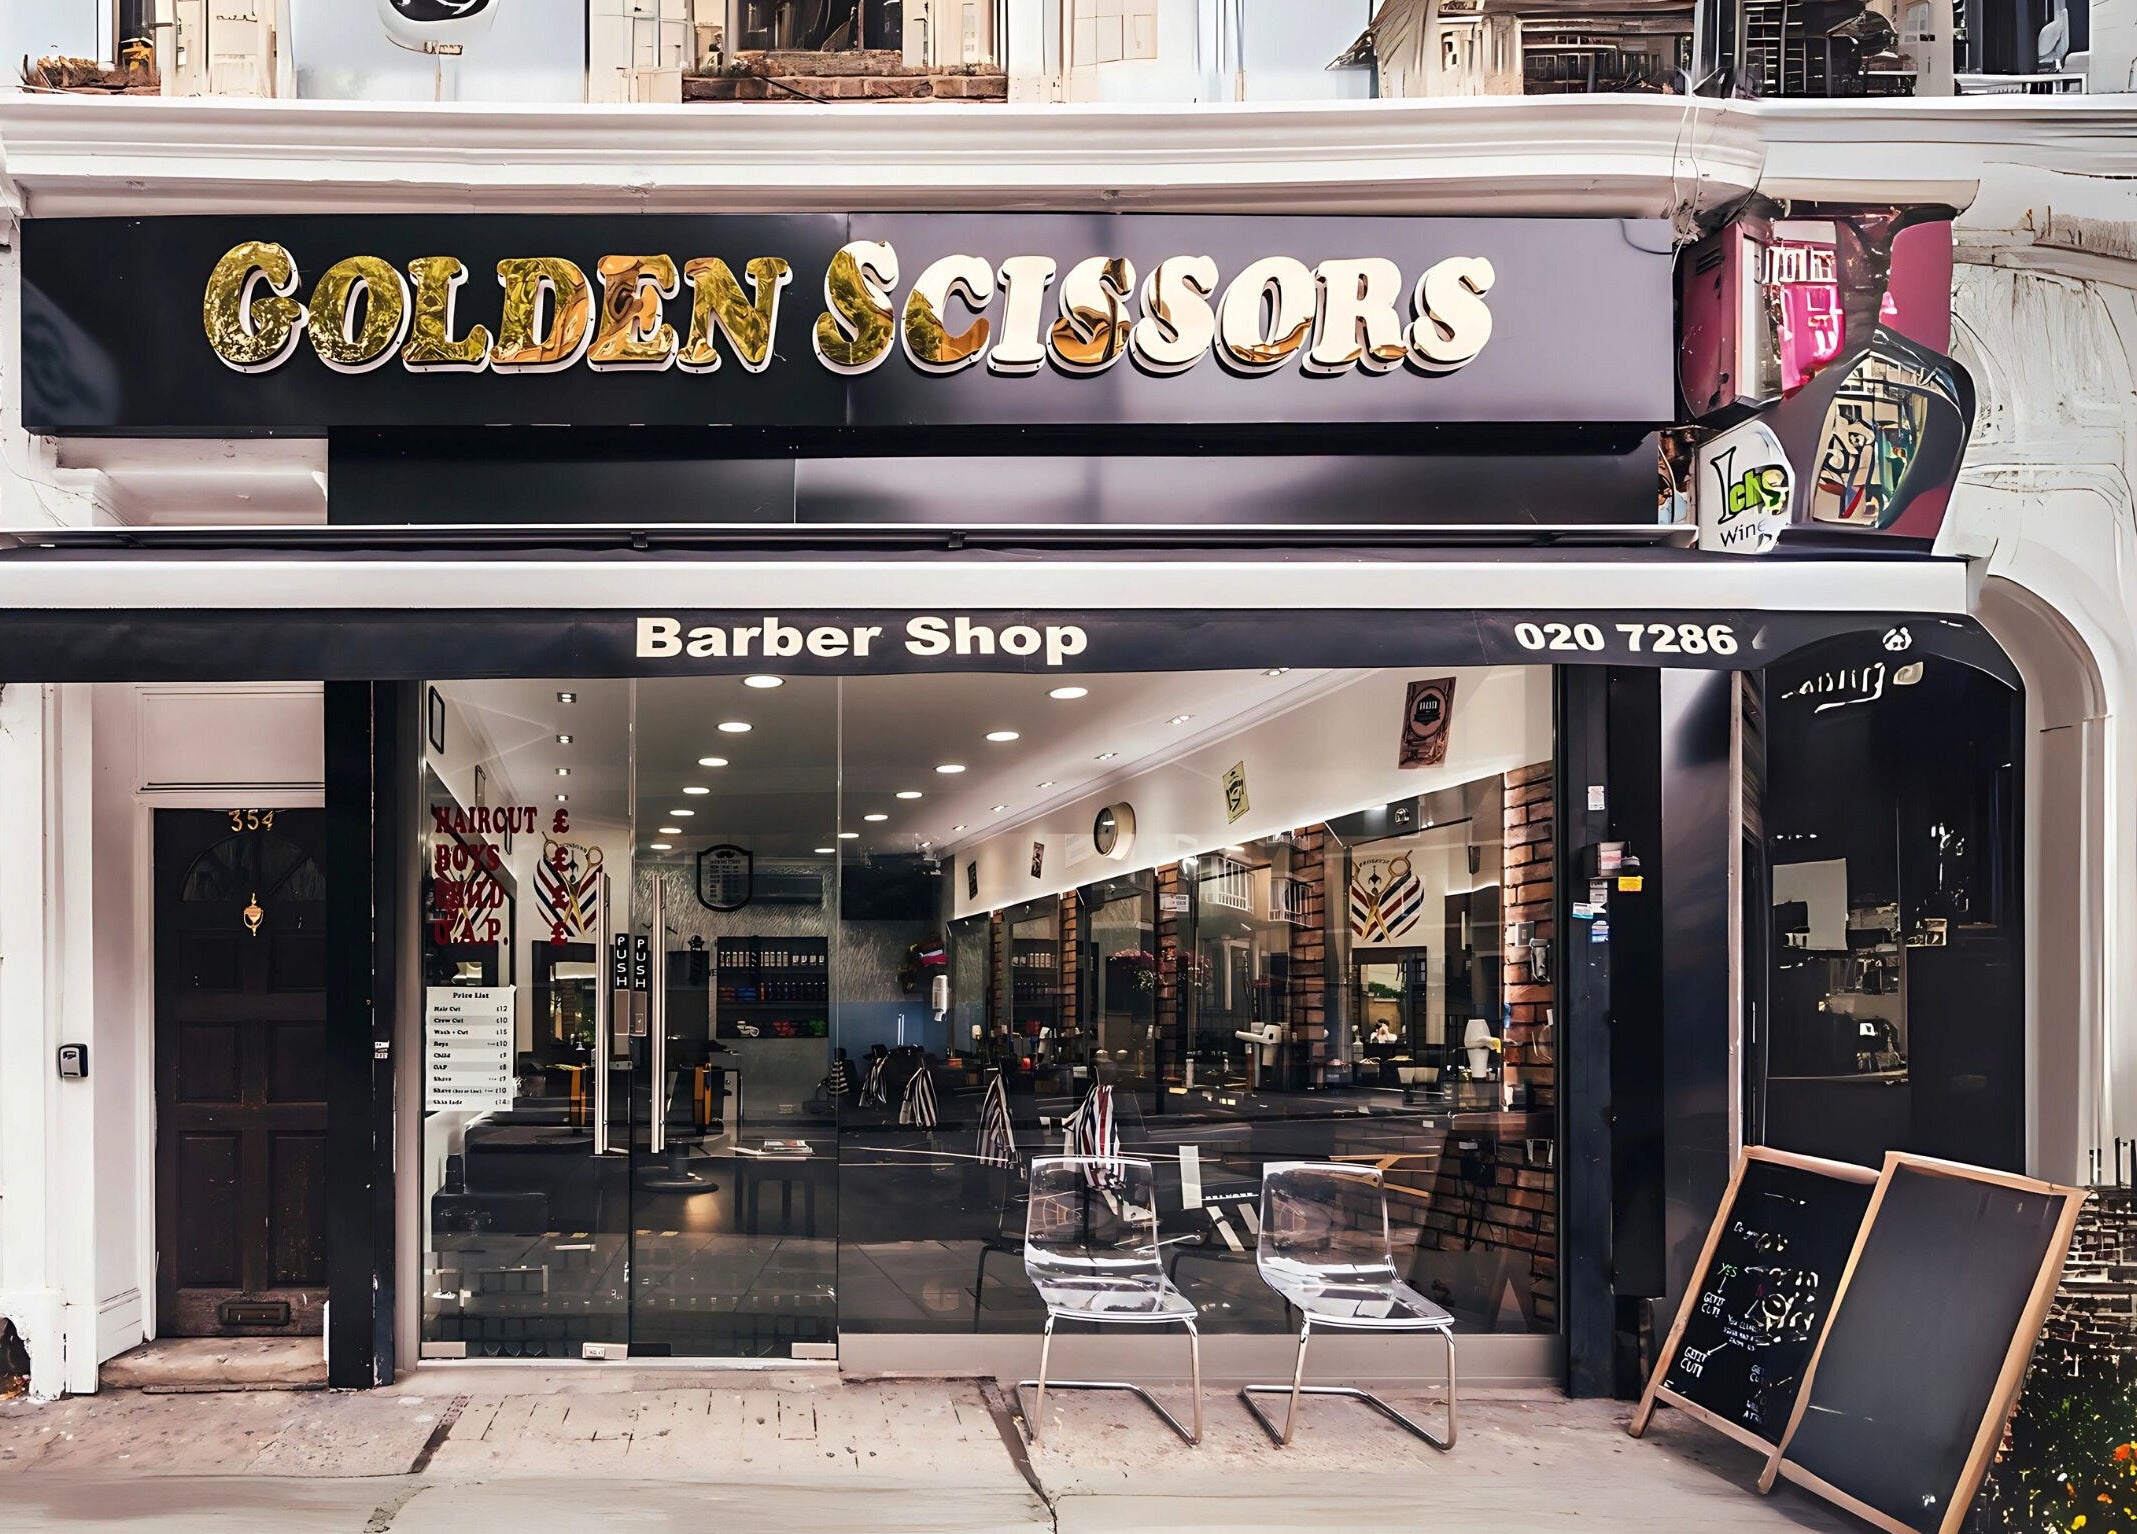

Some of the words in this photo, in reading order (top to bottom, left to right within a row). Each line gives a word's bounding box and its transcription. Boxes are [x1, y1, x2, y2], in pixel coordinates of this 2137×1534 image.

[203, 240, 793, 374] GOLDEN
[812, 240, 1496, 376] SCISSORS
[636, 616, 883, 657] Barber
[905, 616, 1088, 666] Shop
[1514, 622, 1605, 651] 020
[1615, 624, 1739, 655] 7286
[228, 808, 274, 832] 354
[434, 806, 538, 834] HAIRCUT
[552, 808, 570, 834] £
[434, 844, 500, 871] BOYS
[616, 936, 628, 987] PUSH
[635, 938, 647, 988] PUSH
[1717, 1262, 1738, 1279] YES
